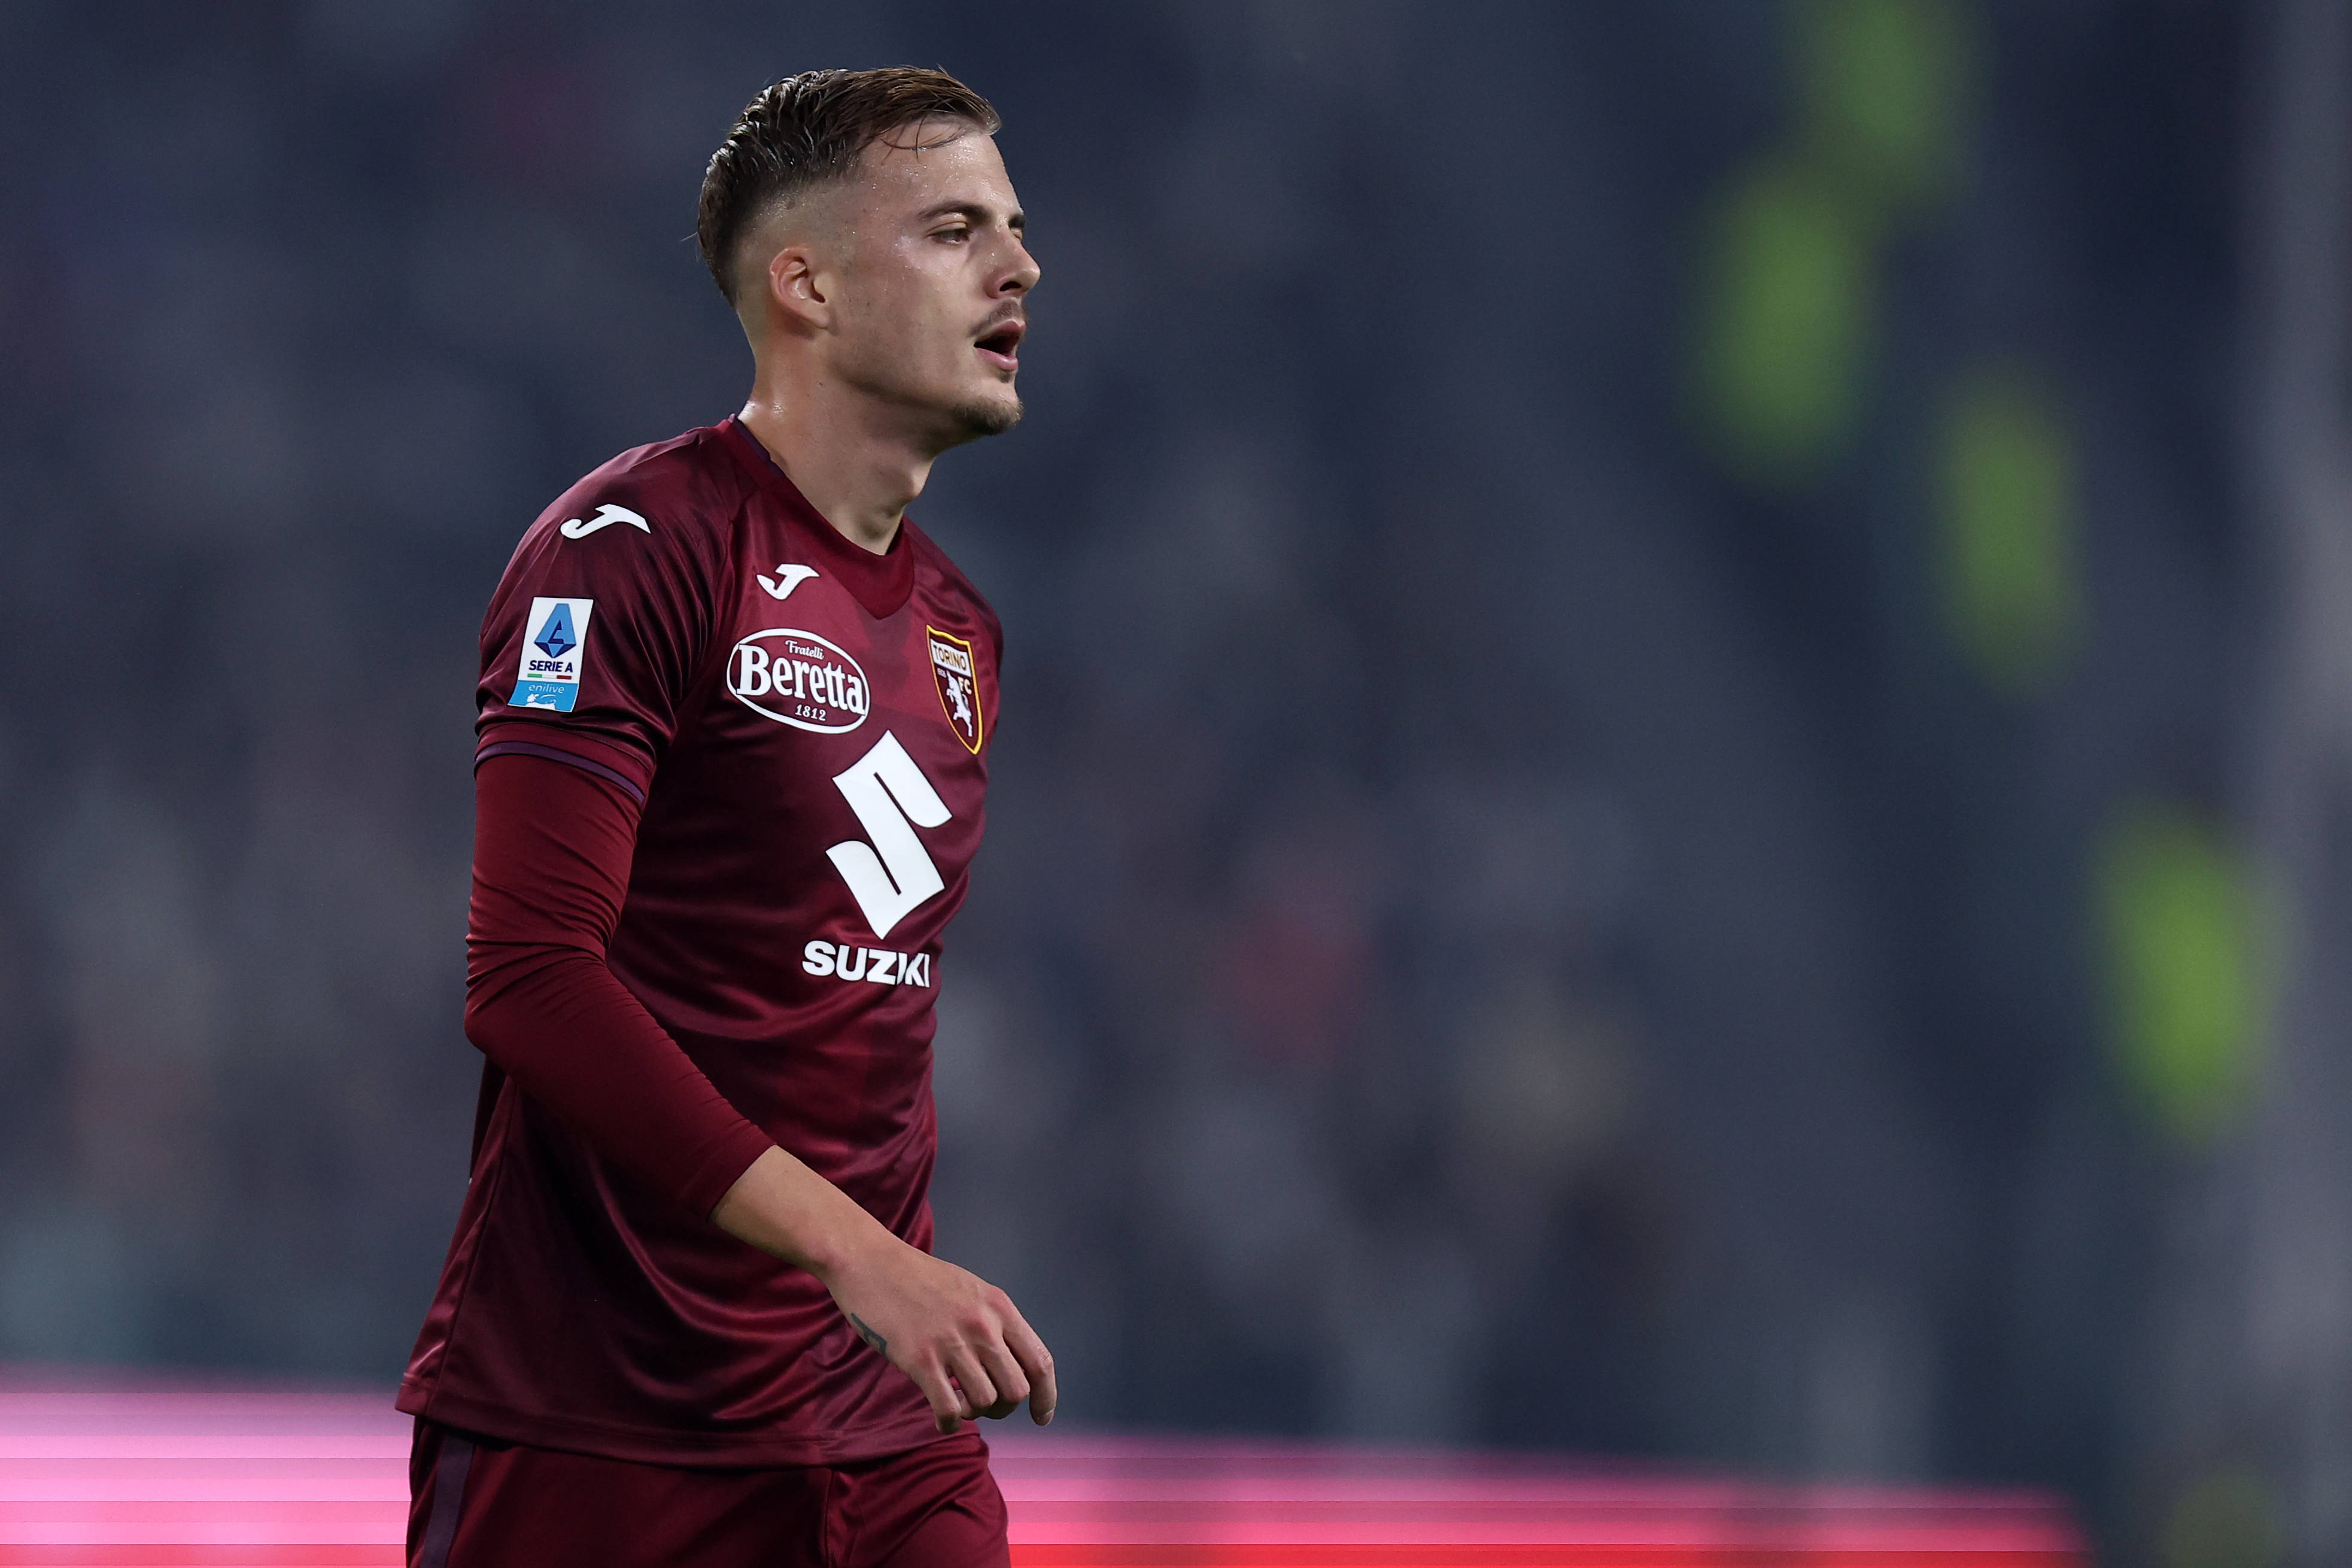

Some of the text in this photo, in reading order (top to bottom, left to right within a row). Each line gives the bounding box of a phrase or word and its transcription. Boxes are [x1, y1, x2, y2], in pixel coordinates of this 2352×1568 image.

[785, 640, 825, 660] Fratelli
[933, 644, 967, 670] TORINO
[528, 660, 573, 673] SERIE A
[528, 683, 565, 694] enilive
[736, 643, 865, 716] Beretta
[958, 676, 972, 695] FC
[795, 704, 826, 722] 1812
